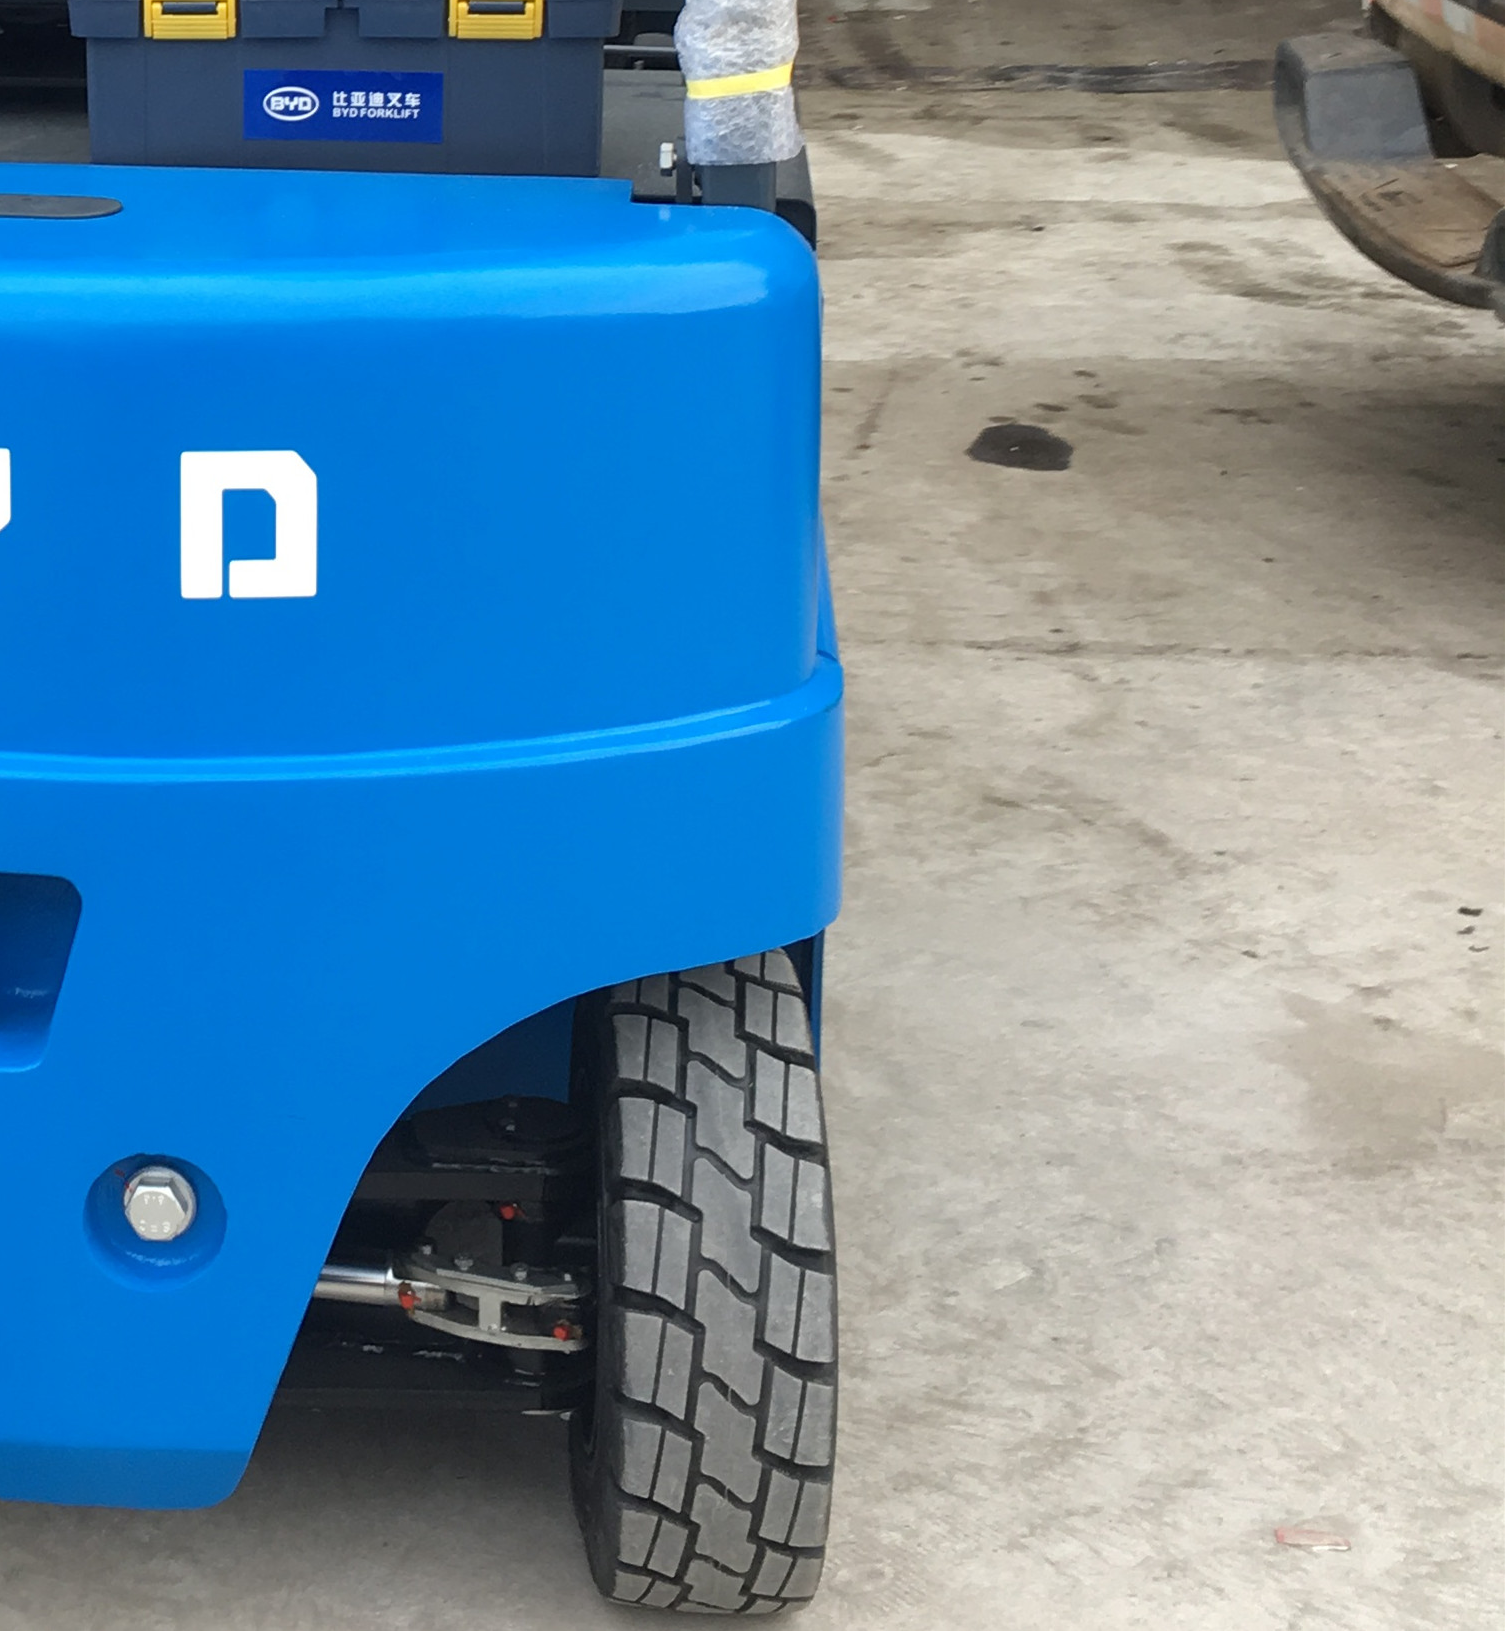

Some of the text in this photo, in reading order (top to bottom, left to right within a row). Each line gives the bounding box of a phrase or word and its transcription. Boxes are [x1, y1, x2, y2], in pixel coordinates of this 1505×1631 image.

[270, 96, 312, 111] BYD
[332, 90, 421, 108] 比亚迪叉车
[332, 108, 420, 119] BYD FORKLIFT
